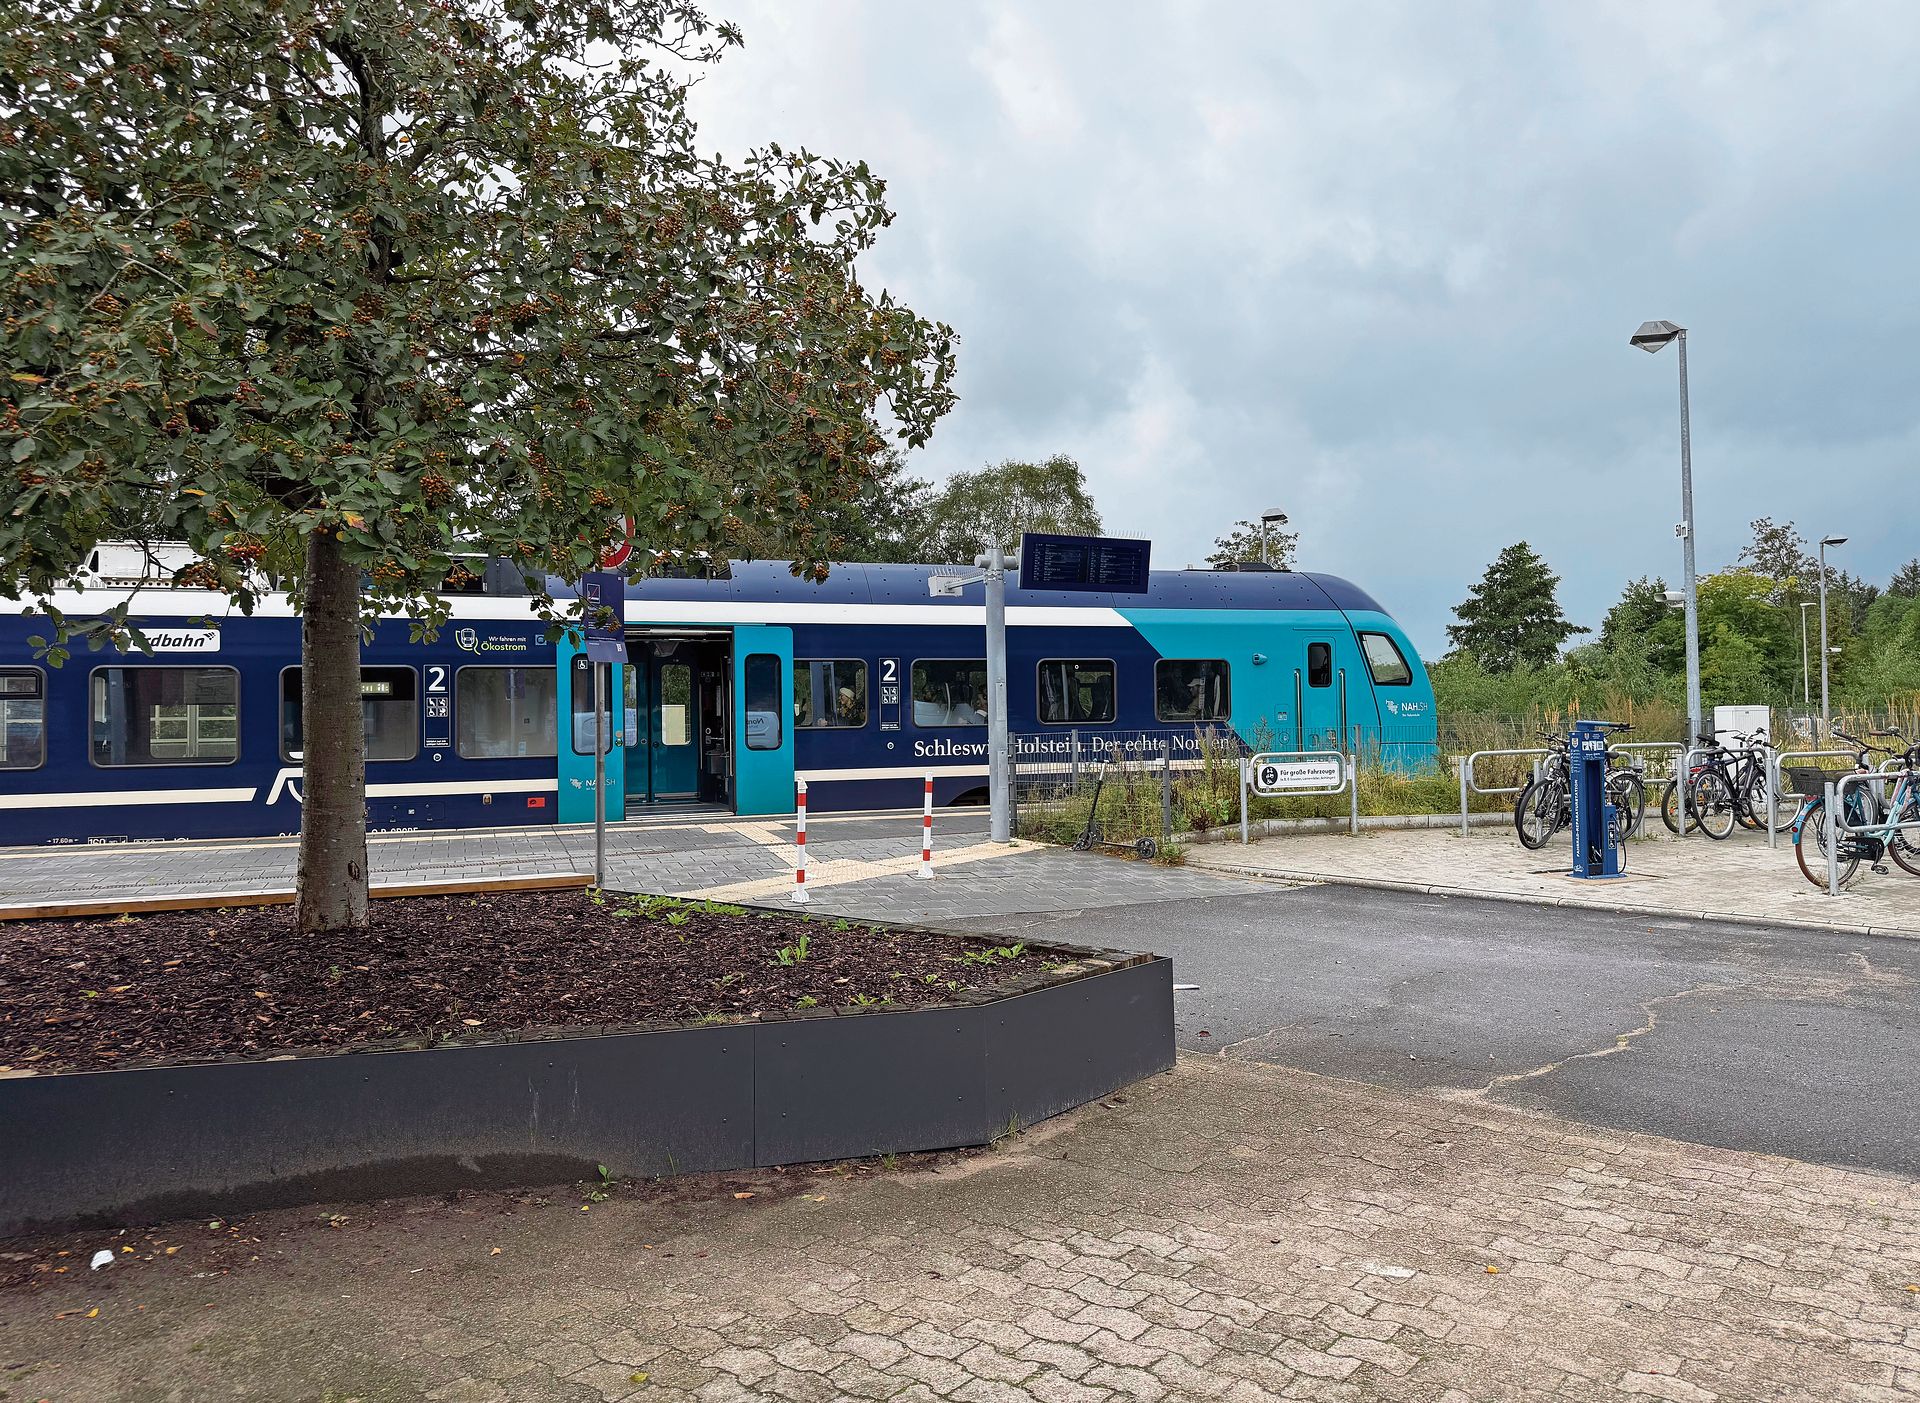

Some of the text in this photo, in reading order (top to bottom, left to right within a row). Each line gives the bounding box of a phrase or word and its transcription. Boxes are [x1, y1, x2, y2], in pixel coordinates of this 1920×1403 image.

[132, 633, 205, 647] dbahn
[481, 641, 526, 651] Ökostrom
[883, 660, 896, 681] 2
[428, 667, 446, 691] 2
[1092, 737, 1120, 752] Der
